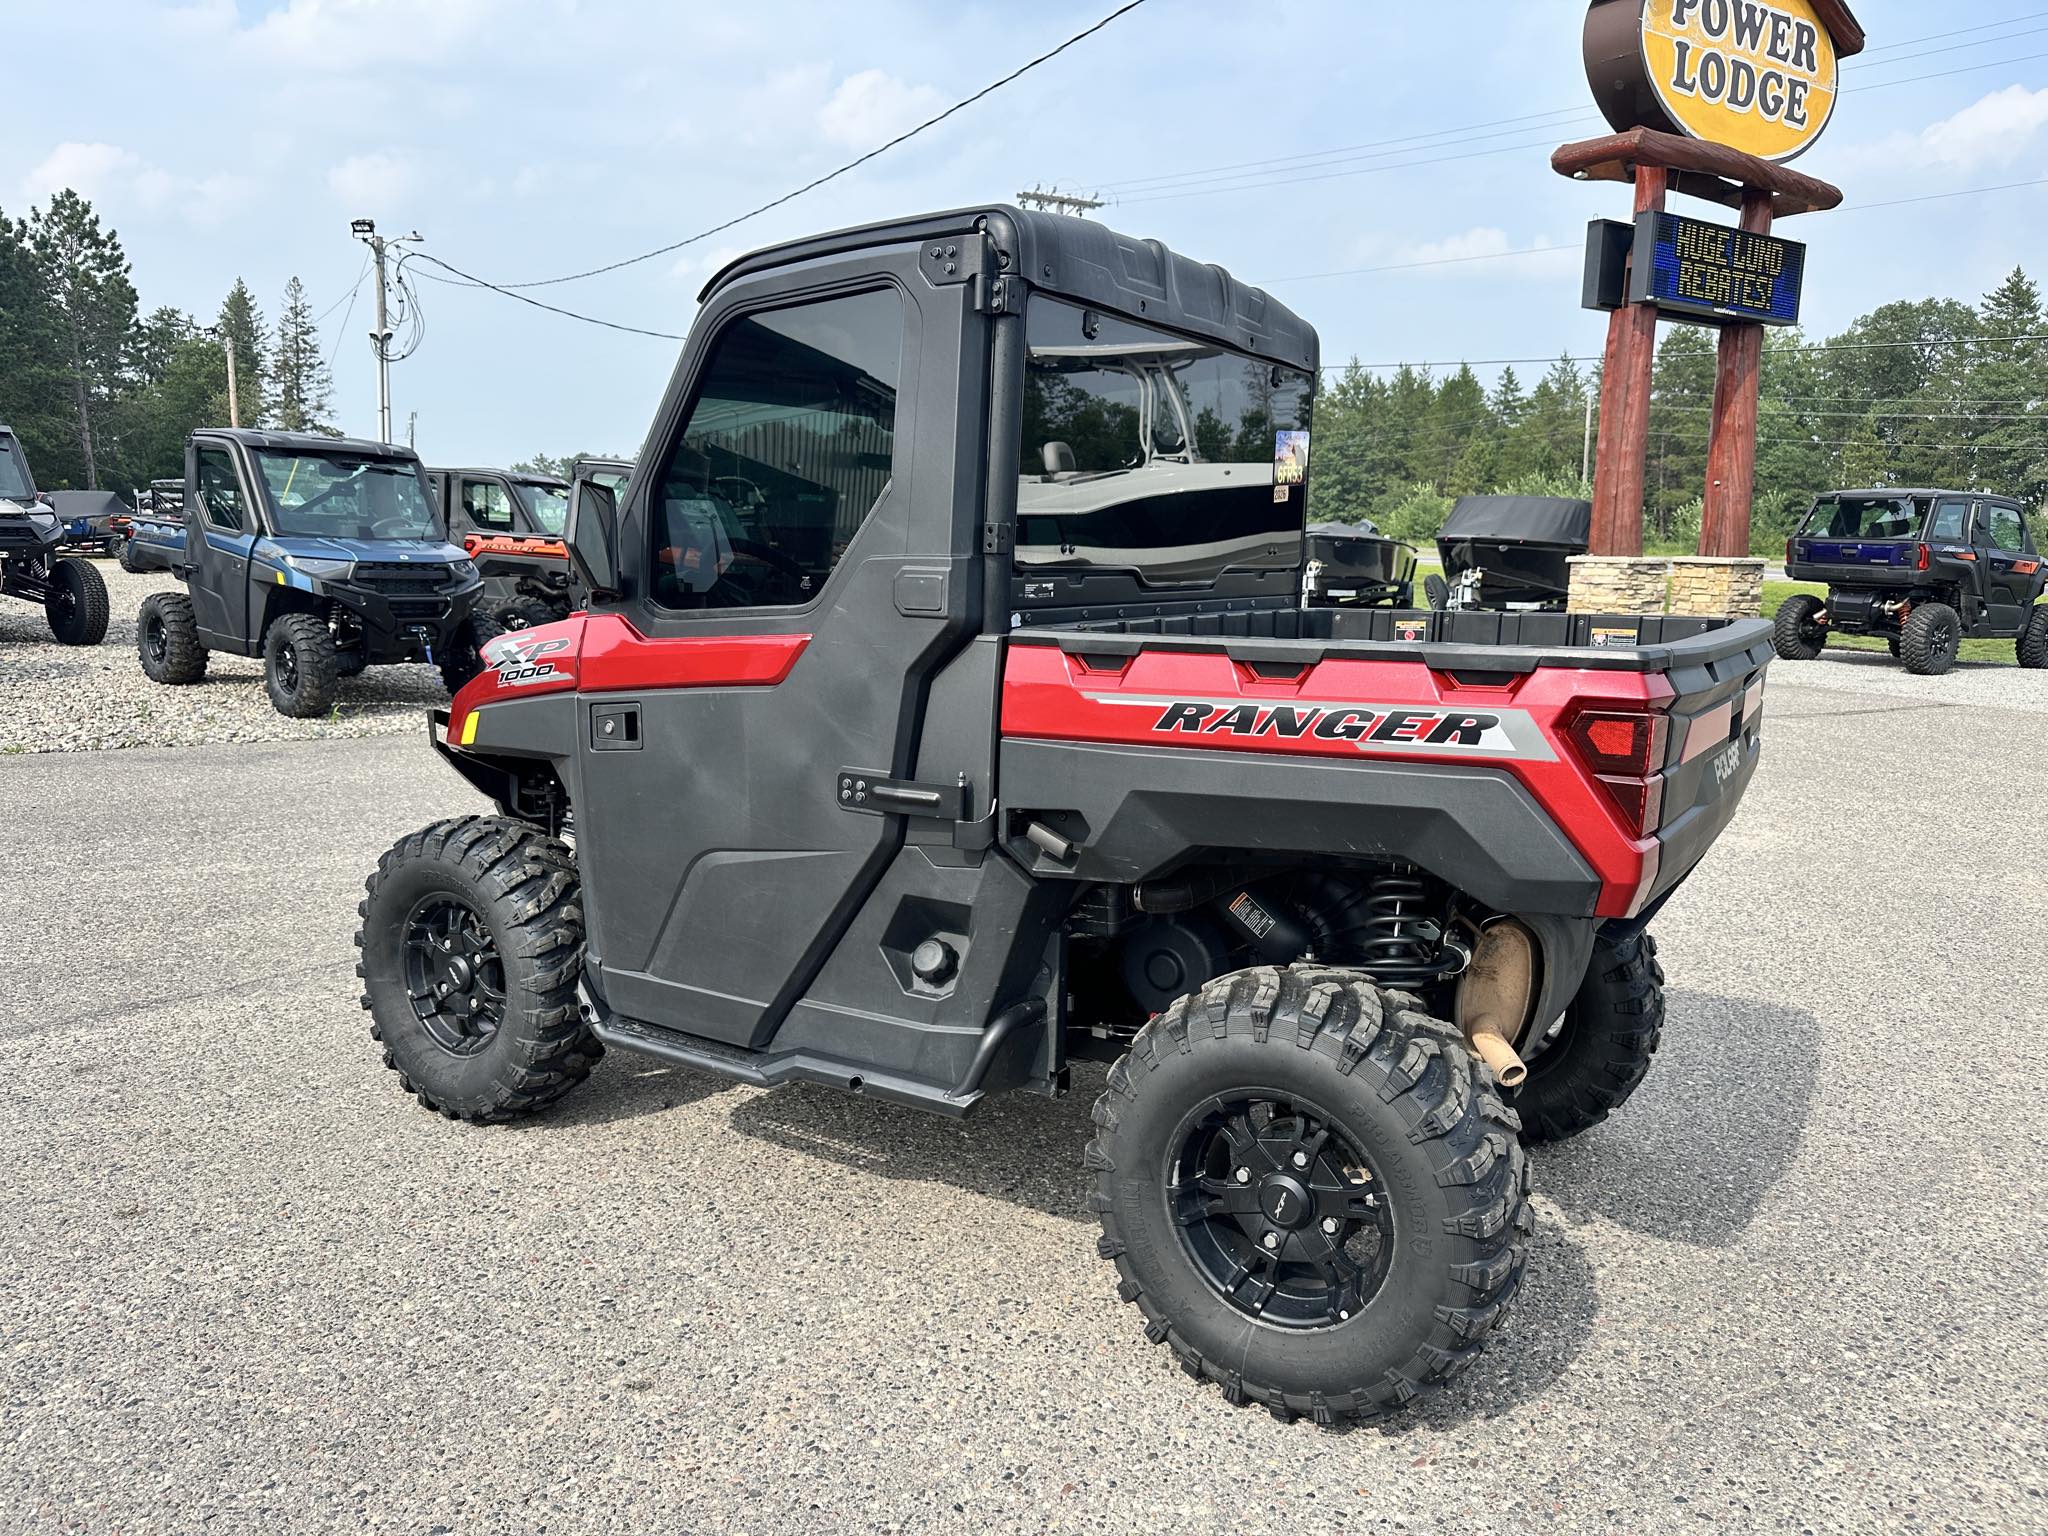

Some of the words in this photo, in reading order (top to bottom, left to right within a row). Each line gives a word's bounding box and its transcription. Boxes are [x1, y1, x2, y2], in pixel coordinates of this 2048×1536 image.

[1673, 0, 1816, 72] POWER
[1673, 41, 1808, 126] LODGE
[1676, 222, 1730, 265] HUGE
[1733, 235, 1783, 275] LUND
[1678, 260, 1773, 309] REBATES!
[490, 639, 570, 670] XP
[499, 665, 554, 682] 1000
[1156, 702, 1501, 745] RANGER
